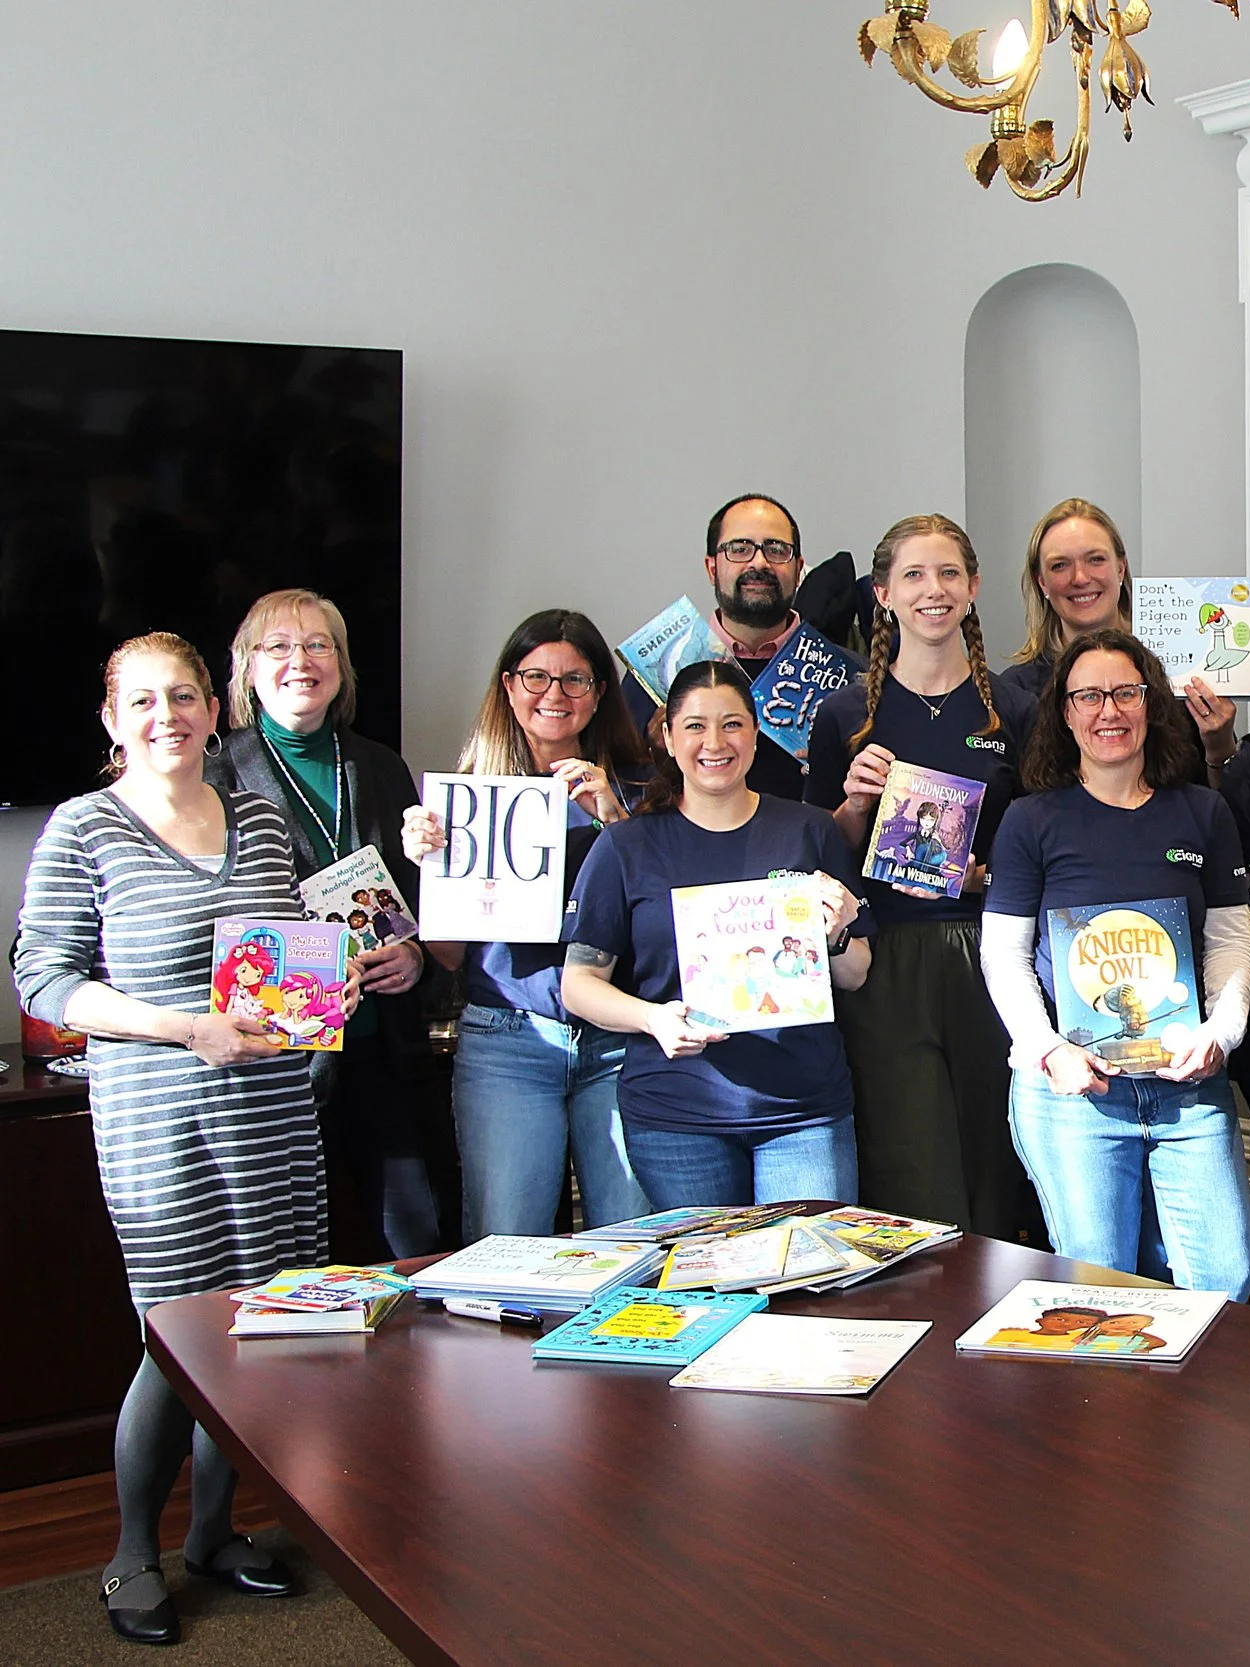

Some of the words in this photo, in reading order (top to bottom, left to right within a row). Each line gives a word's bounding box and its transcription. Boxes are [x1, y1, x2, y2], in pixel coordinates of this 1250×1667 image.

[1139, 584, 1176, 594] Don't
[1139, 597, 1165, 608] Let
[1171, 596, 1194, 607] the
[1139, 610, 1188, 623] Pigeon
[638, 614, 690, 658] SHARKS
[1139, 625, 1182, 636] Drive
[794, 636, 834, 666] How
[777, 659, 795, 678] to
[800, 663, 849, 690] Catch
[910, 777, 969, 805] WEDNESDAY
[435, 782, 557, 882] BIG
[320, 876, 355, 897] Madrigal
[355, 860, 380, 883] Family
[336, 857, 366, 878] Magical
[718, 895, 765, 913] you
[713, 908, 775, 935] loved
[291, 936, 305, 947] My
[307, 936, 329, 946] First
[1076, 927, 1166, 966] KNIGHT
[288, 947, 332, 961] Sleepover
[1099, 956, 1149, 986] OWL
[1052, 1296, 1136, 1309] Believe
